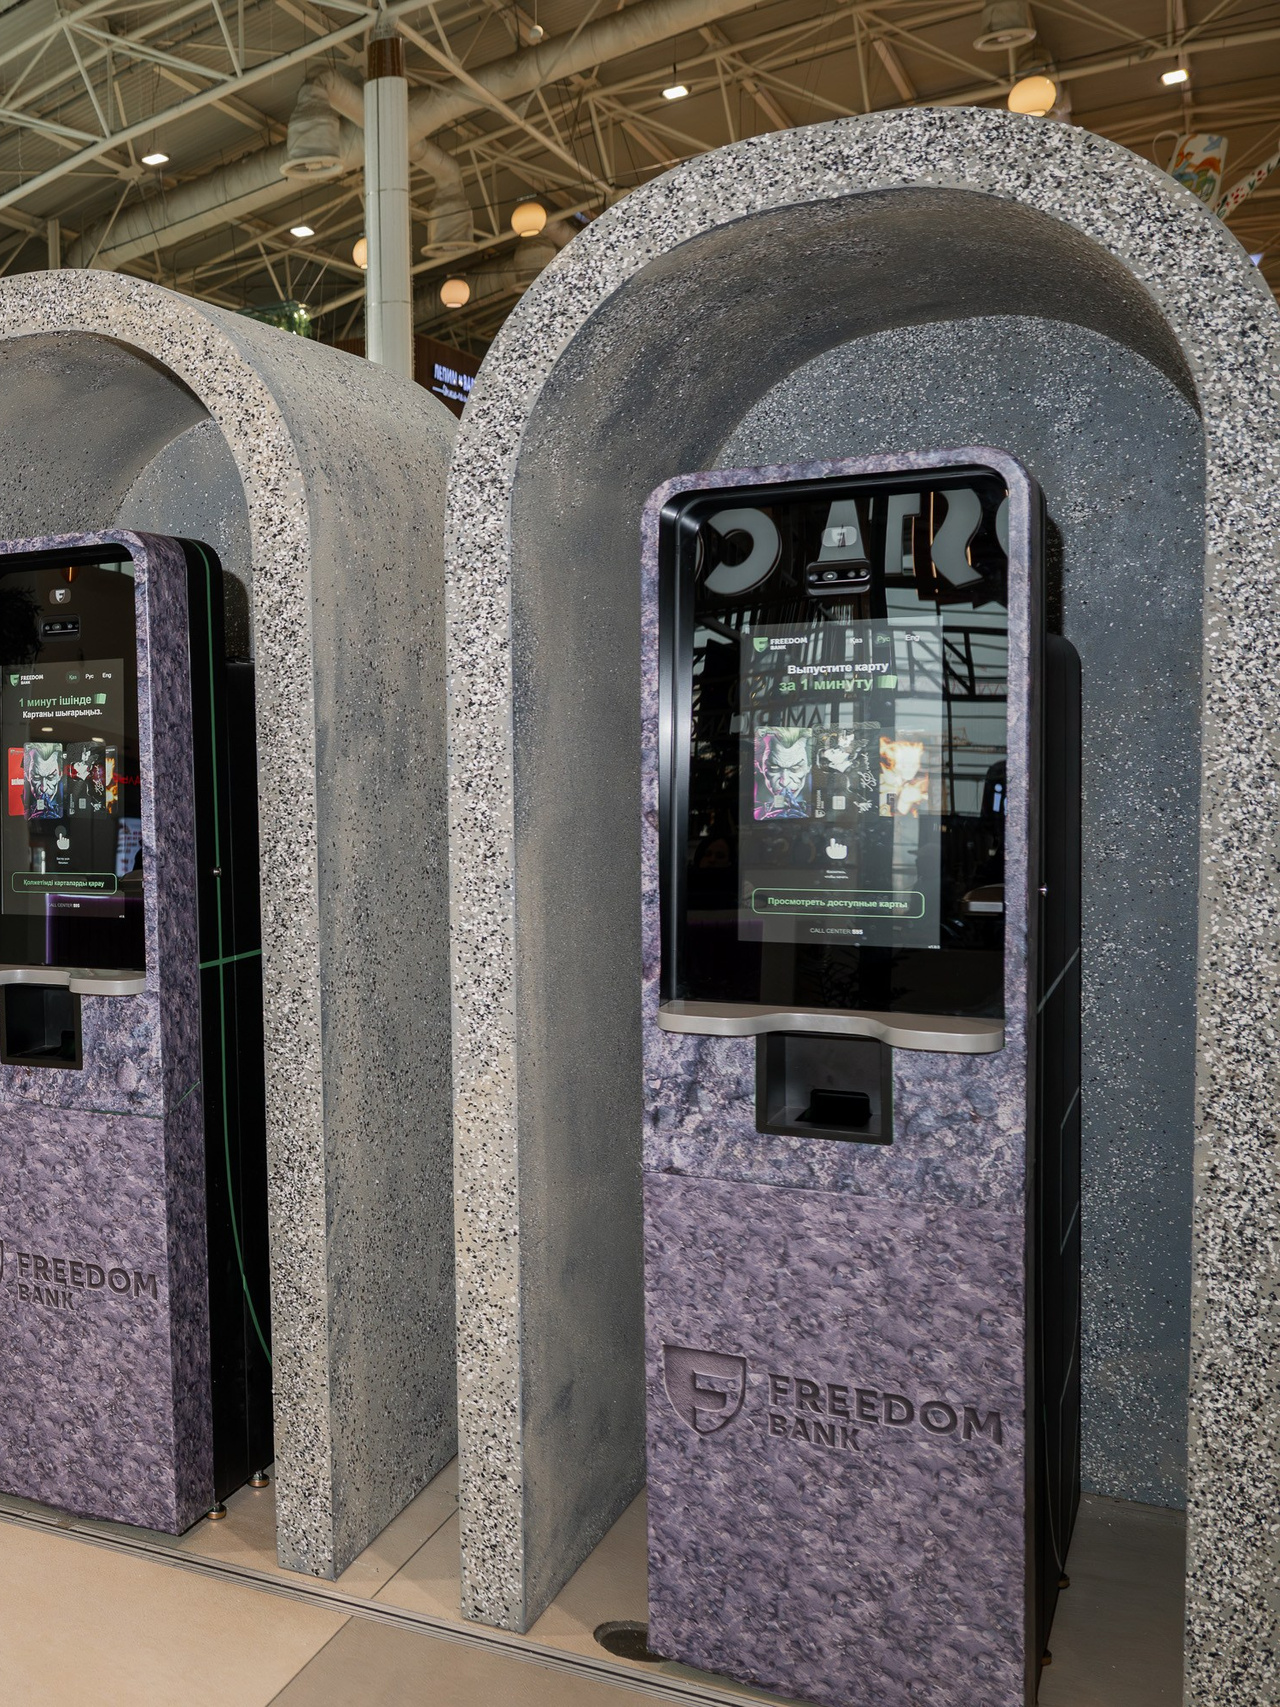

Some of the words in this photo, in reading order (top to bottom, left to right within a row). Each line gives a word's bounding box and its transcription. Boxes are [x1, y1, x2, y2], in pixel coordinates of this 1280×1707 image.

[770, 636, 808, 646] FREEDOM
[876, 635, 891, 644] Рус
[905, 633, 920, 643] Eng
[787, 663, 853, 676] Выпустите
[855, 661, 890, 675] карту
[102, 672, 112, 680] Eng
[779, 681, 796, 692] за
[800, 679, 809, 691] 1
[814, 677, 874, 692] минуту
[19, 698, 24, 708] 1
[27, 698, 57, 709] минут
[59, 695, 92, 707] ішінде
[22, 710, 54, 720] Картаны
[768, 897, 826, 908] Просмотреть
[827, 899, 878, 909] доступные
[879, 900, 908, 909] карты
[17, 1251, 158, 1301] FREEDOM
[18, 1283, 75, 1311] BANK
[768, 1373, 1004, 1446] FREEDOM
[769, 1413, 861, 1451] BANK
